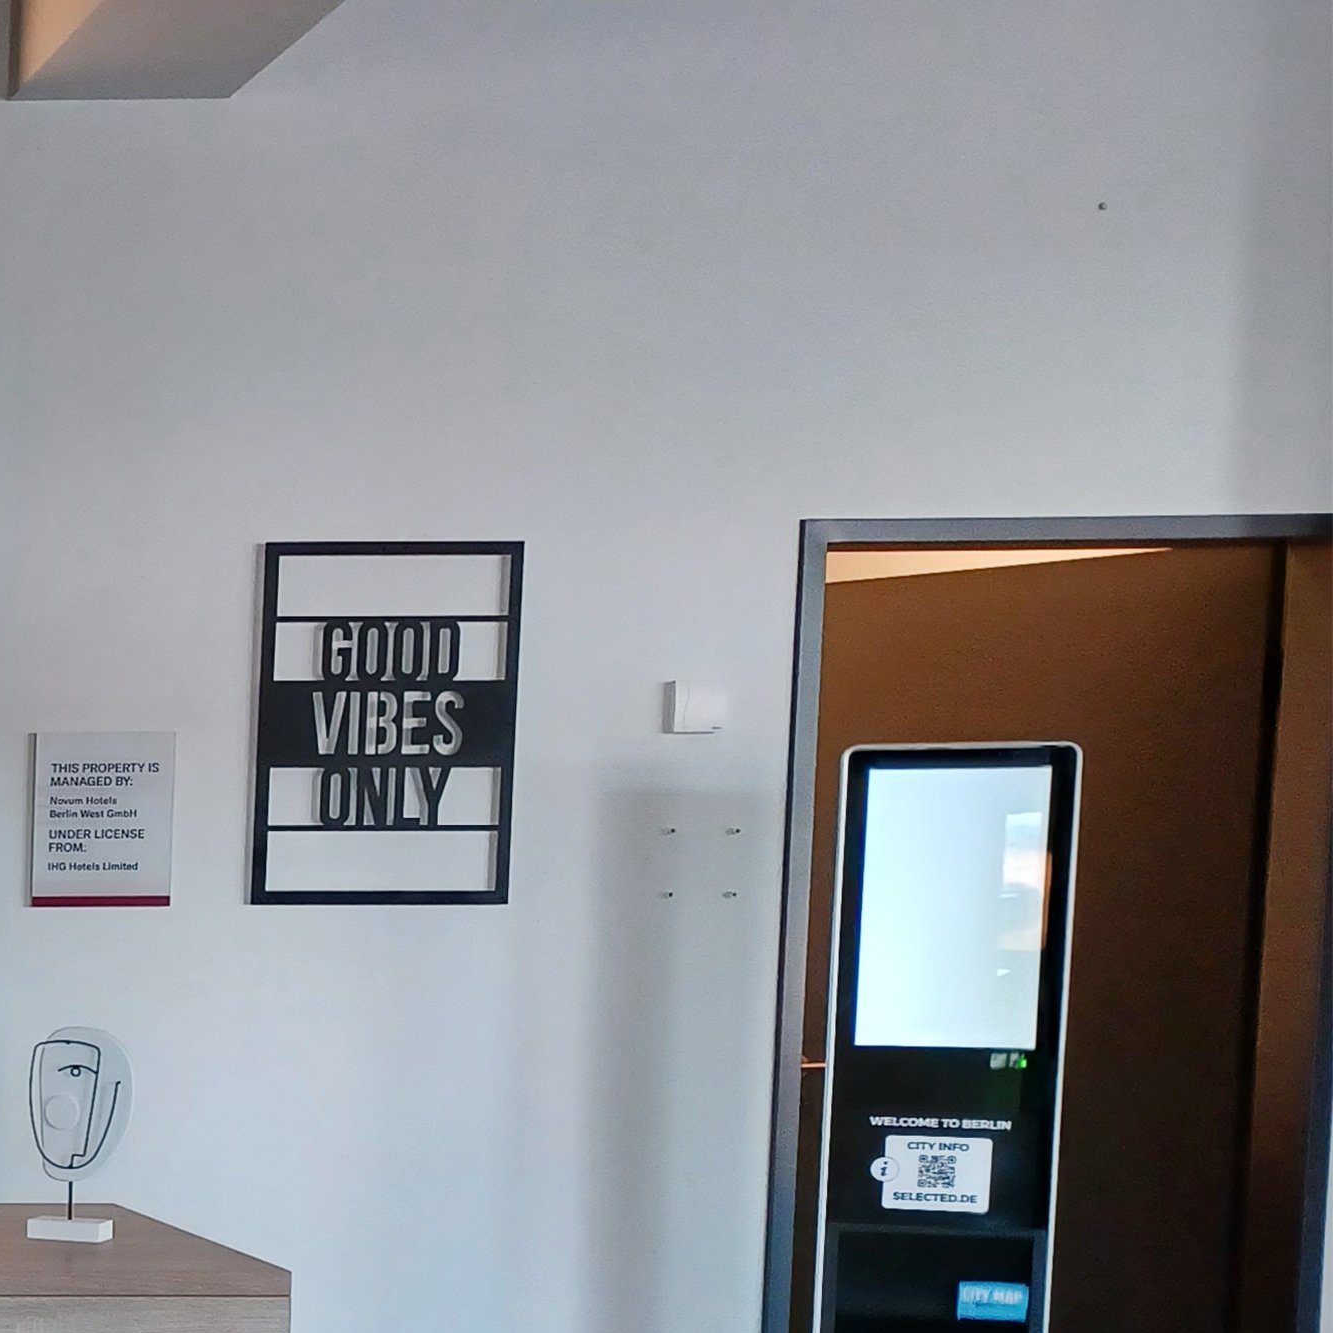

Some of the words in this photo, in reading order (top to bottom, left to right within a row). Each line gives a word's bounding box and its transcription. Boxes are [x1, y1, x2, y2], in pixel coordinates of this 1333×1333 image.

[321, 620, 461, 681] GOOD
[312, 690, 465, 755] VIBES
[51, 763, 79, 773] THIS
[82, 763, 145, 773] PROPERTY
[148, 762, 160, 773] IS
[50, 776, 112, 786] MANAGED
[115, 776, 133, 786] BY:
[49, 796, 83, 805] Novum
[86, 796, 117, 805] Hotels
[320, 766, 452, 826] ONLY
[49, 809, 78, 818] Berlin
[80, 809, 104, 818] West
[107, 809, 137, 818] GmbH
[48, 829, 91, 839] UNDER
[94, 829, 145, 839] LICENSE
[48, 842, 87, 852] FROM:
[47, 862, 66, 871] IHG
[69, 862, 100, 871] Hotels
[103, 861, 138, 871] Limited
[869, 1116, 939, 1128] WELCOME
[942, 1118, 960, 1128] TO
[962, 1119, 1012, 1131] BERLIN
[907, 1141, 936, 1150] CITY
[938, 1142, 970, 1152] INFO
[892, 1191, 978, 1203] SELECTED.DE
